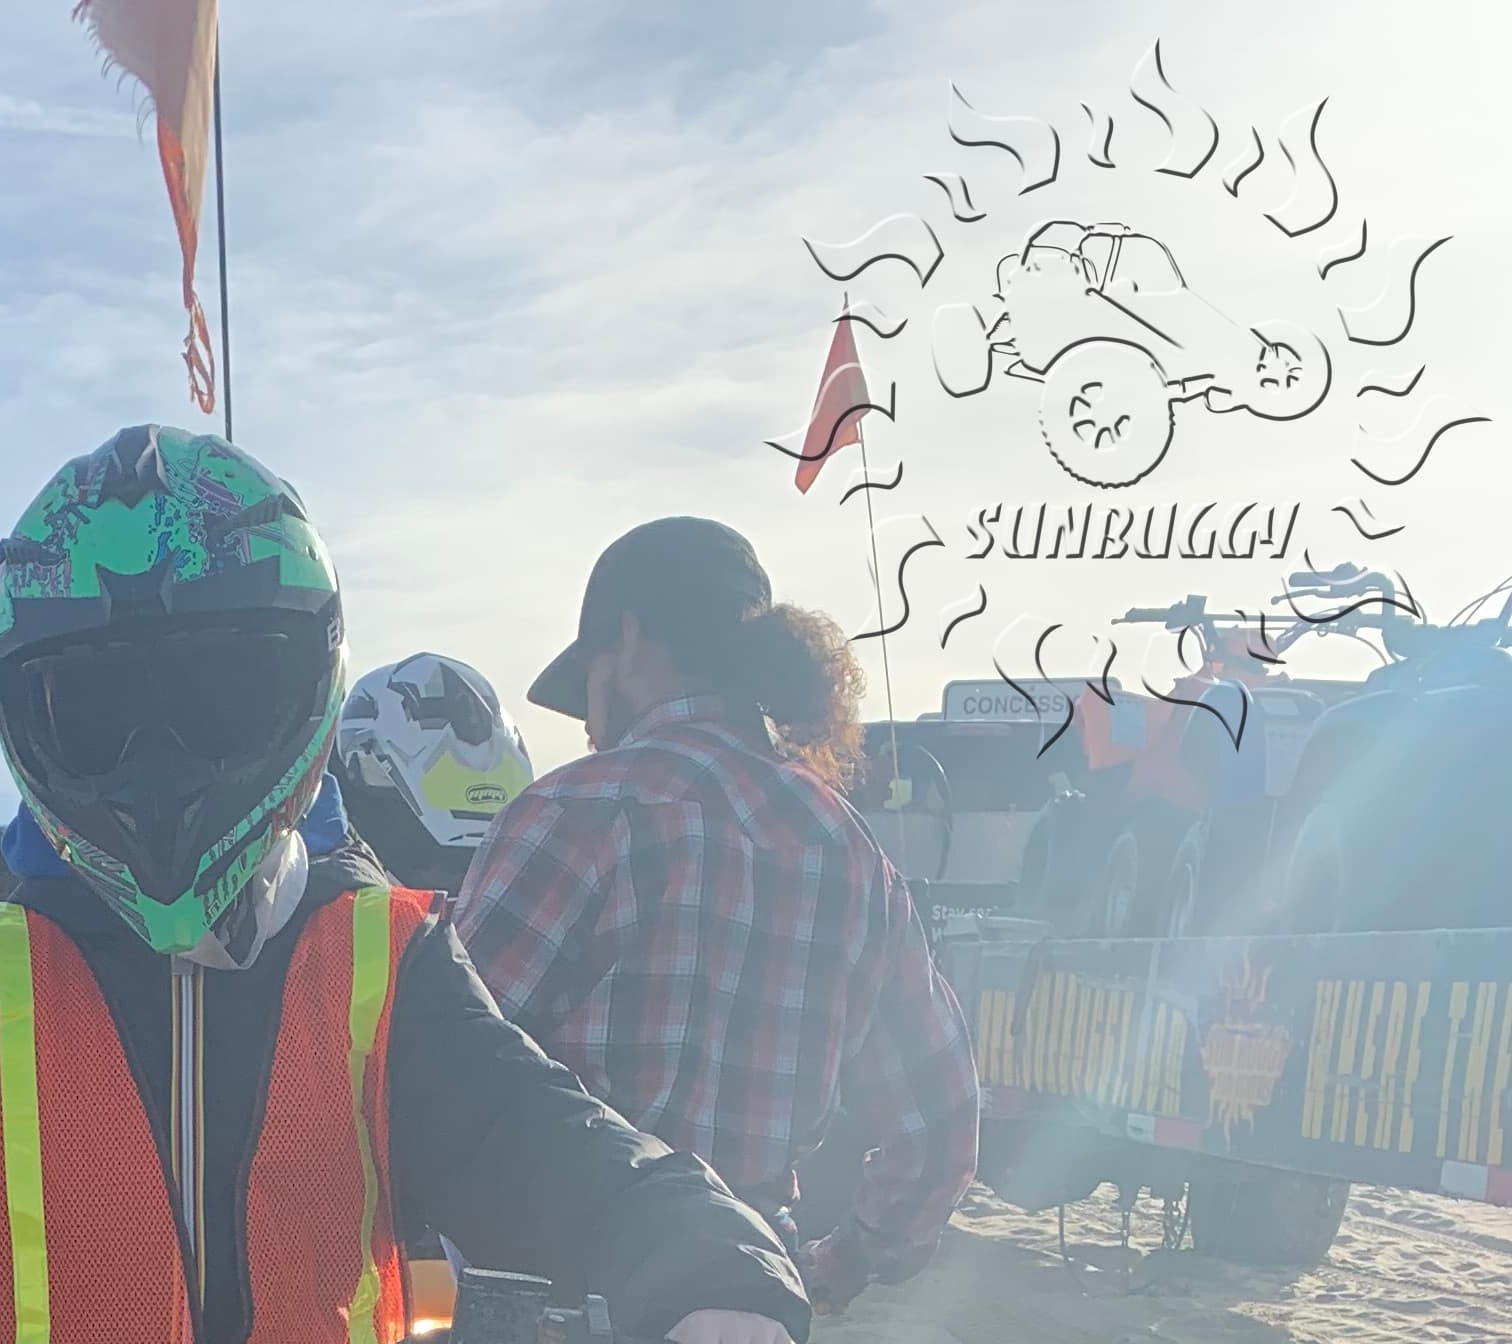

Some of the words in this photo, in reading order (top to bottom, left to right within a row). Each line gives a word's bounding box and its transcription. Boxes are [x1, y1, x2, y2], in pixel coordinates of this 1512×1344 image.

[963, 696, 1080, 715] CONCESSI
[1301, 979, 1432, 1154] WHERE
[1435, 980, 1512, 1165] THE
